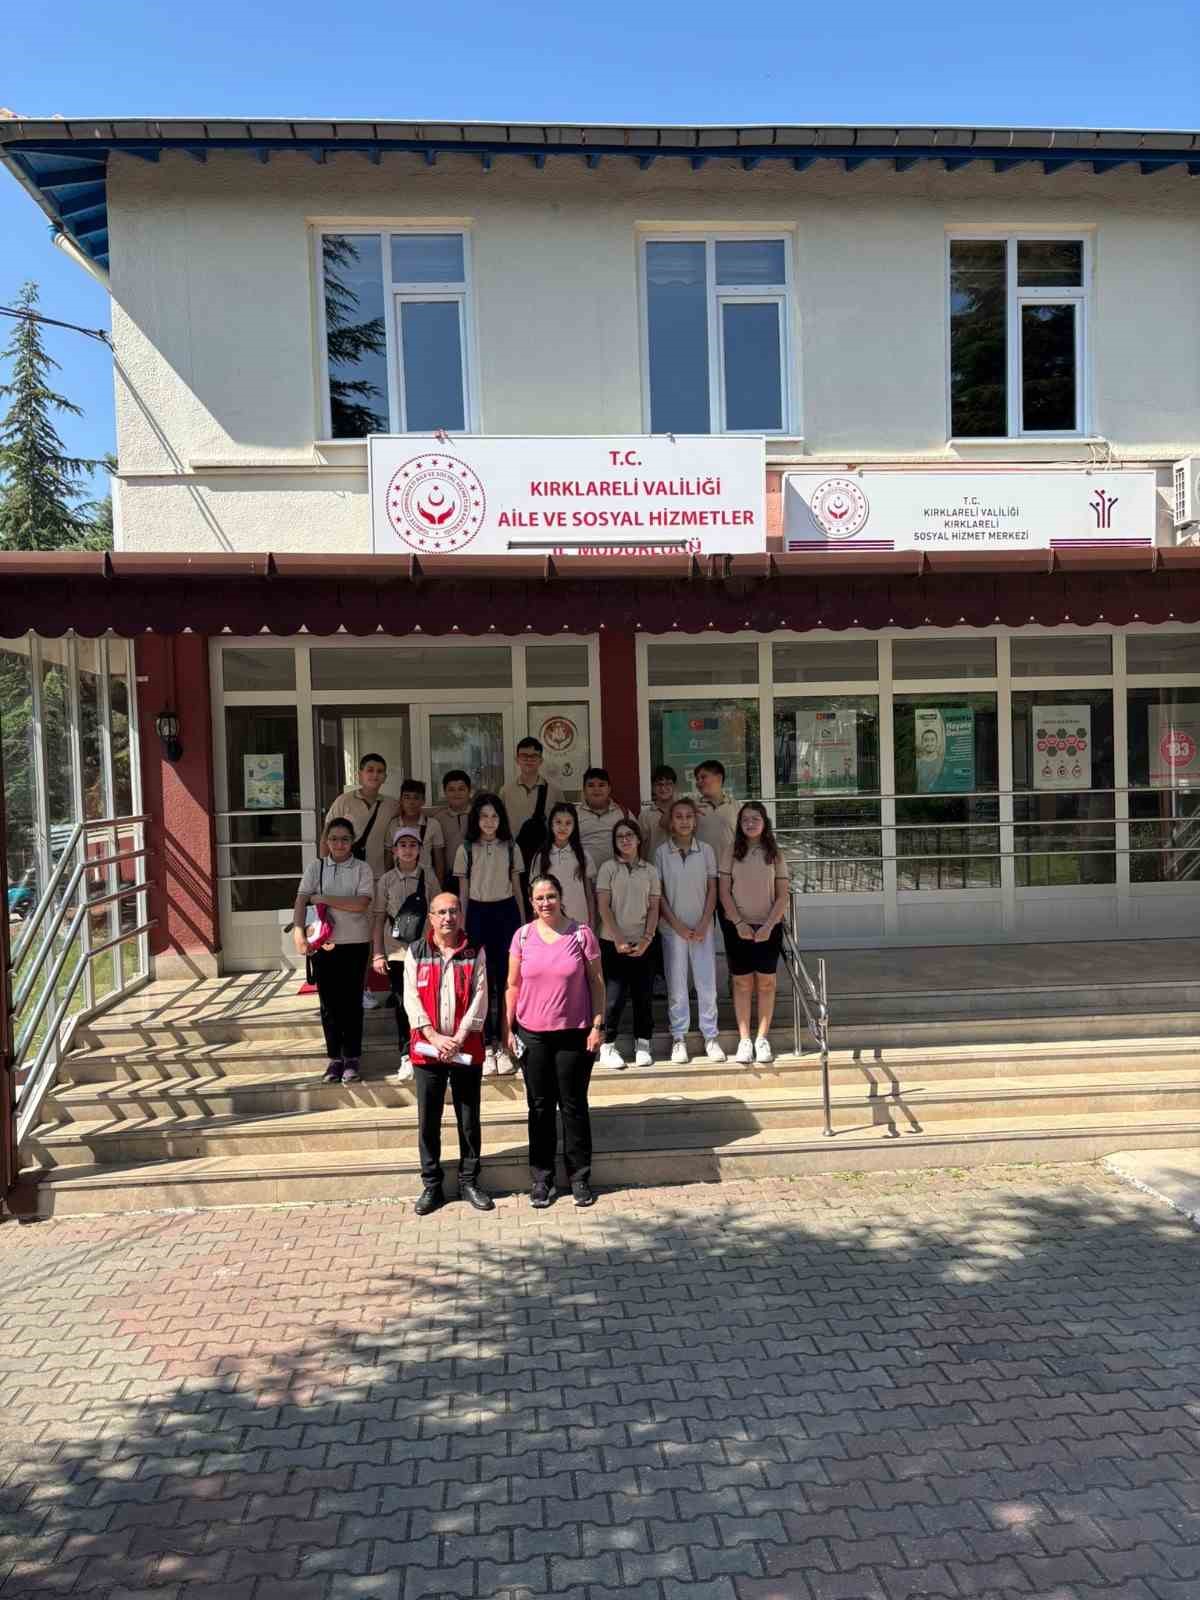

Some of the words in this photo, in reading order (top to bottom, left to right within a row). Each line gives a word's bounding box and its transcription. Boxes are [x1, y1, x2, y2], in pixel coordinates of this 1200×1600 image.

[609, 451, 642, 466] T.C.
[530, 479, 638, 497] KIRKLARELİ
[643, 477, 721, 496] VALİLİĞİ
[963, 496, 981, 505] T.C.
[923, 506, 979, 517] KIRKLARELİ
[981, 505, 1020, 517] VALİLİĞİ
[498, 508, 539, 528] AİLE
[543, 511, 568, 527] VE
[573, 511, 644, 527] SOSYAL
[649, 507, 754, 526] HİZMETLER
[944, 518, 999, 529] KIRKLARELİ
[913, 531, 949, 541] SOSYAL
[951, 530, 986, 541] HİZMET
[988, 529, 1029, 541] MERKEZİ
